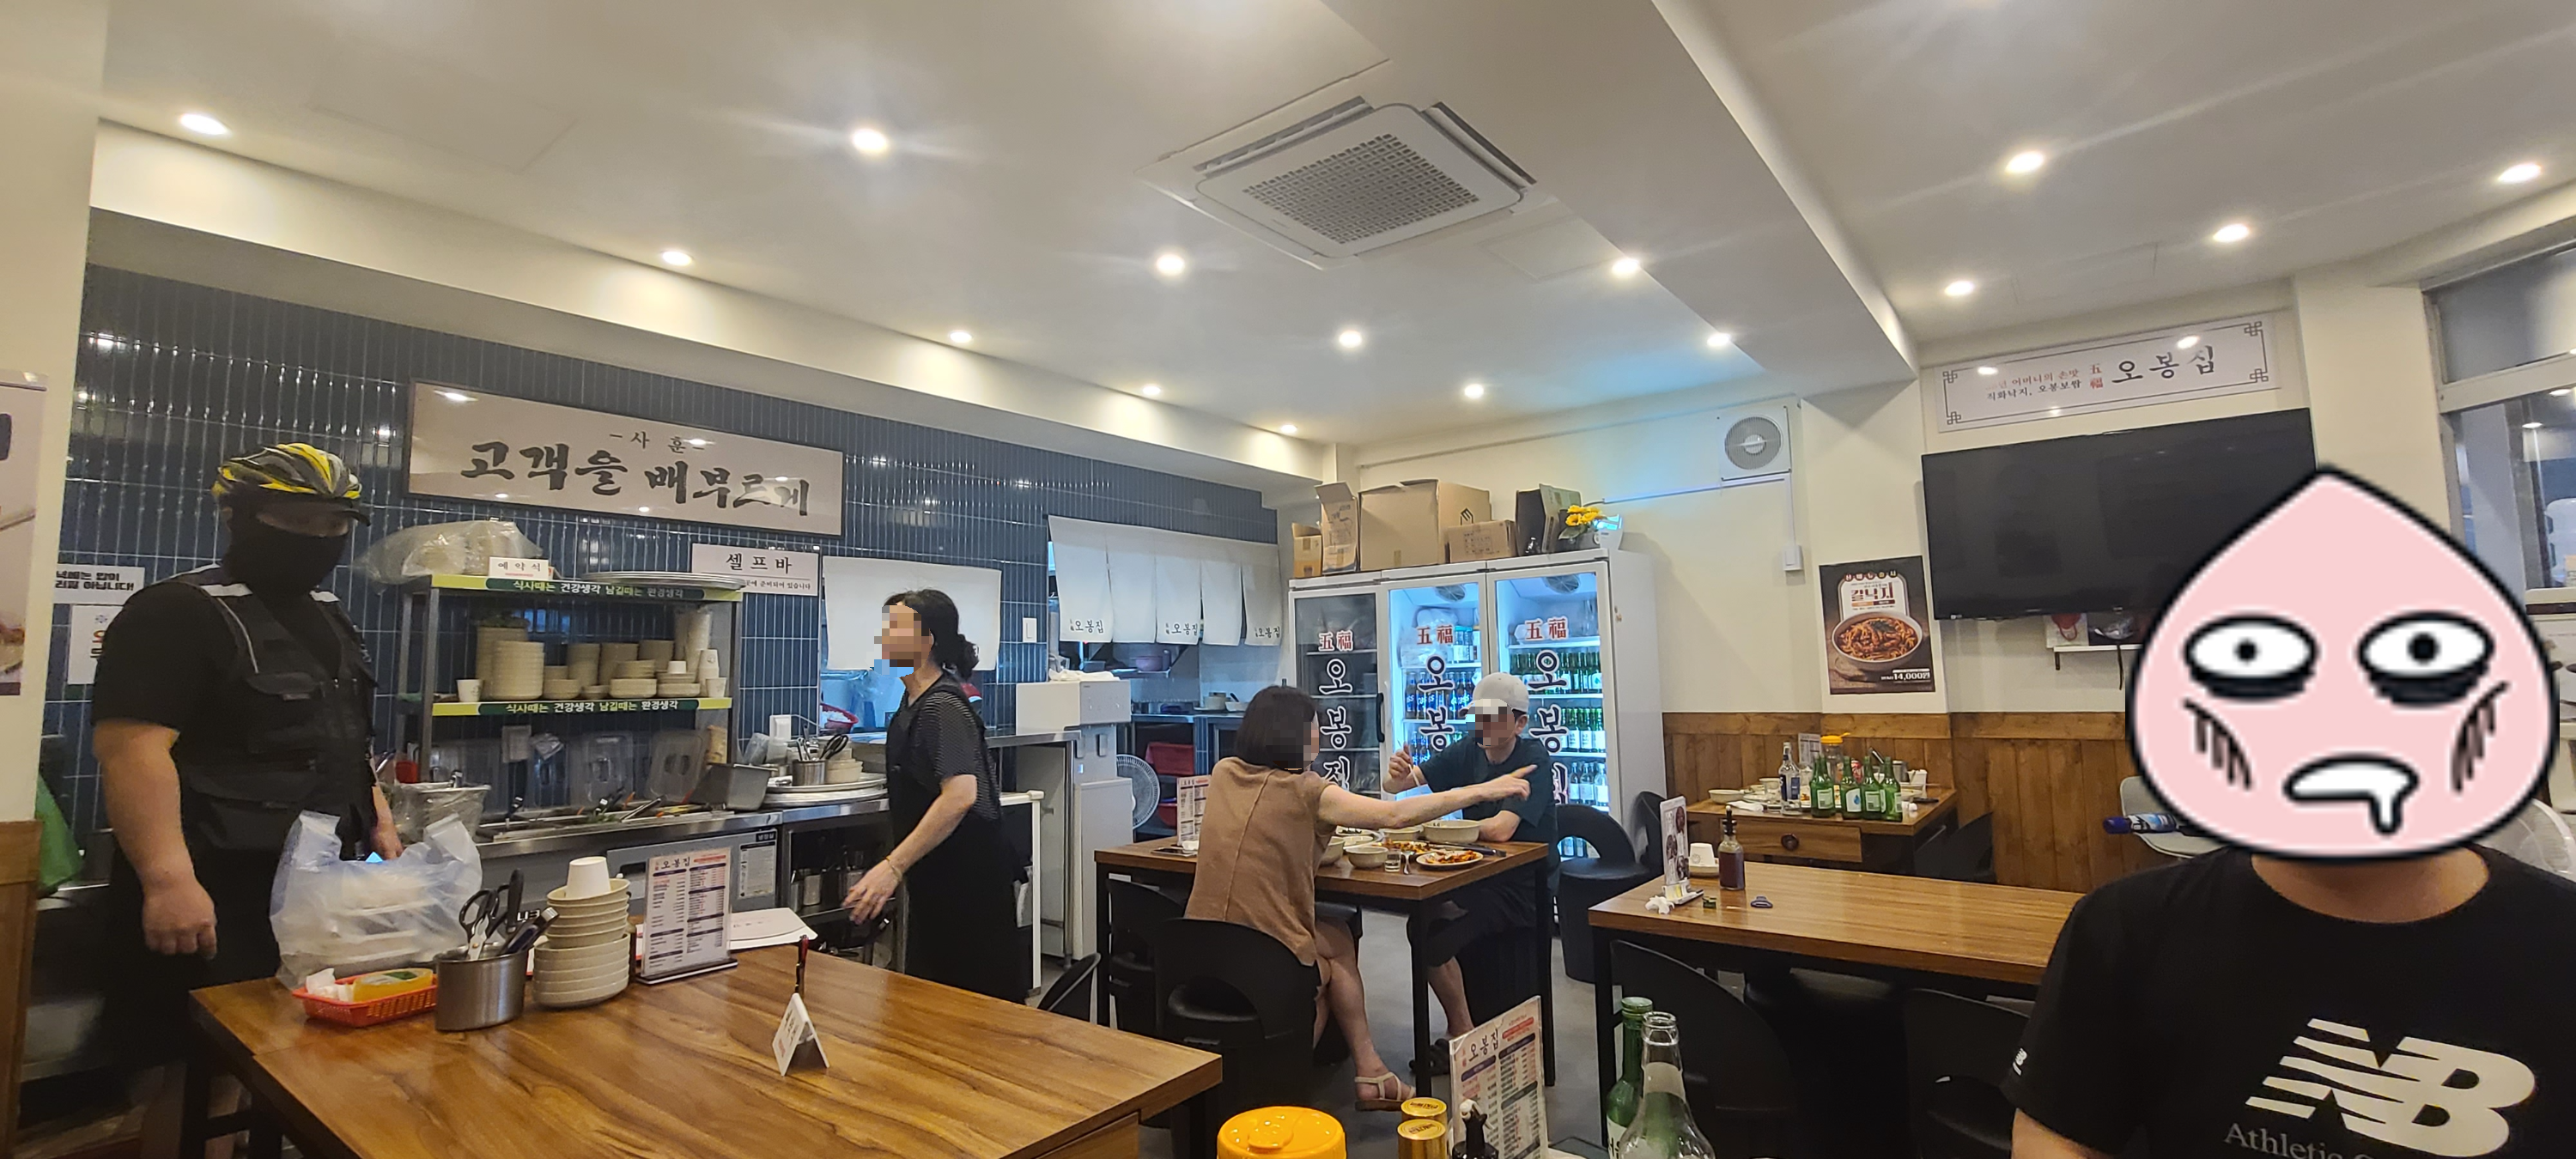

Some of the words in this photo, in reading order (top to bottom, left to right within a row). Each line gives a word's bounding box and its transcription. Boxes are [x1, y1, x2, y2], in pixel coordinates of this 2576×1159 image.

[2012, 373, 2053, 386] 어머니의
[460, 440, 629, 496] 고객을
[645, 460, 810, 517] 배부르게
[83, 581, 134, 591] 아닙니다!
[513, 580, 556, 592] 식사때는
[560, 581, 601, 595] 건강생각
[605, 585, 642, 597] 남길때는
[647, 587, 684, 598] 환경생각
[1074, 620, 1104, 634] 오봉집
[1171, 622, 1198, 635] 오봉집
[1416, 624, 1455, 646] 五福
[1525, 616, 1568, 640] 五福
[1318, 630, 1353, 652] 五福
[506, 703, 550, 713] 식사때는
[553, 701, 595, 713] 건강생각
[599, 701, 638, 712] 남길때는
[641, 701, 679, 710] 환경생각
[1418, 655, 1455, 752] 오봉
[1468, 1029, 1498, 1062] 오봉집
